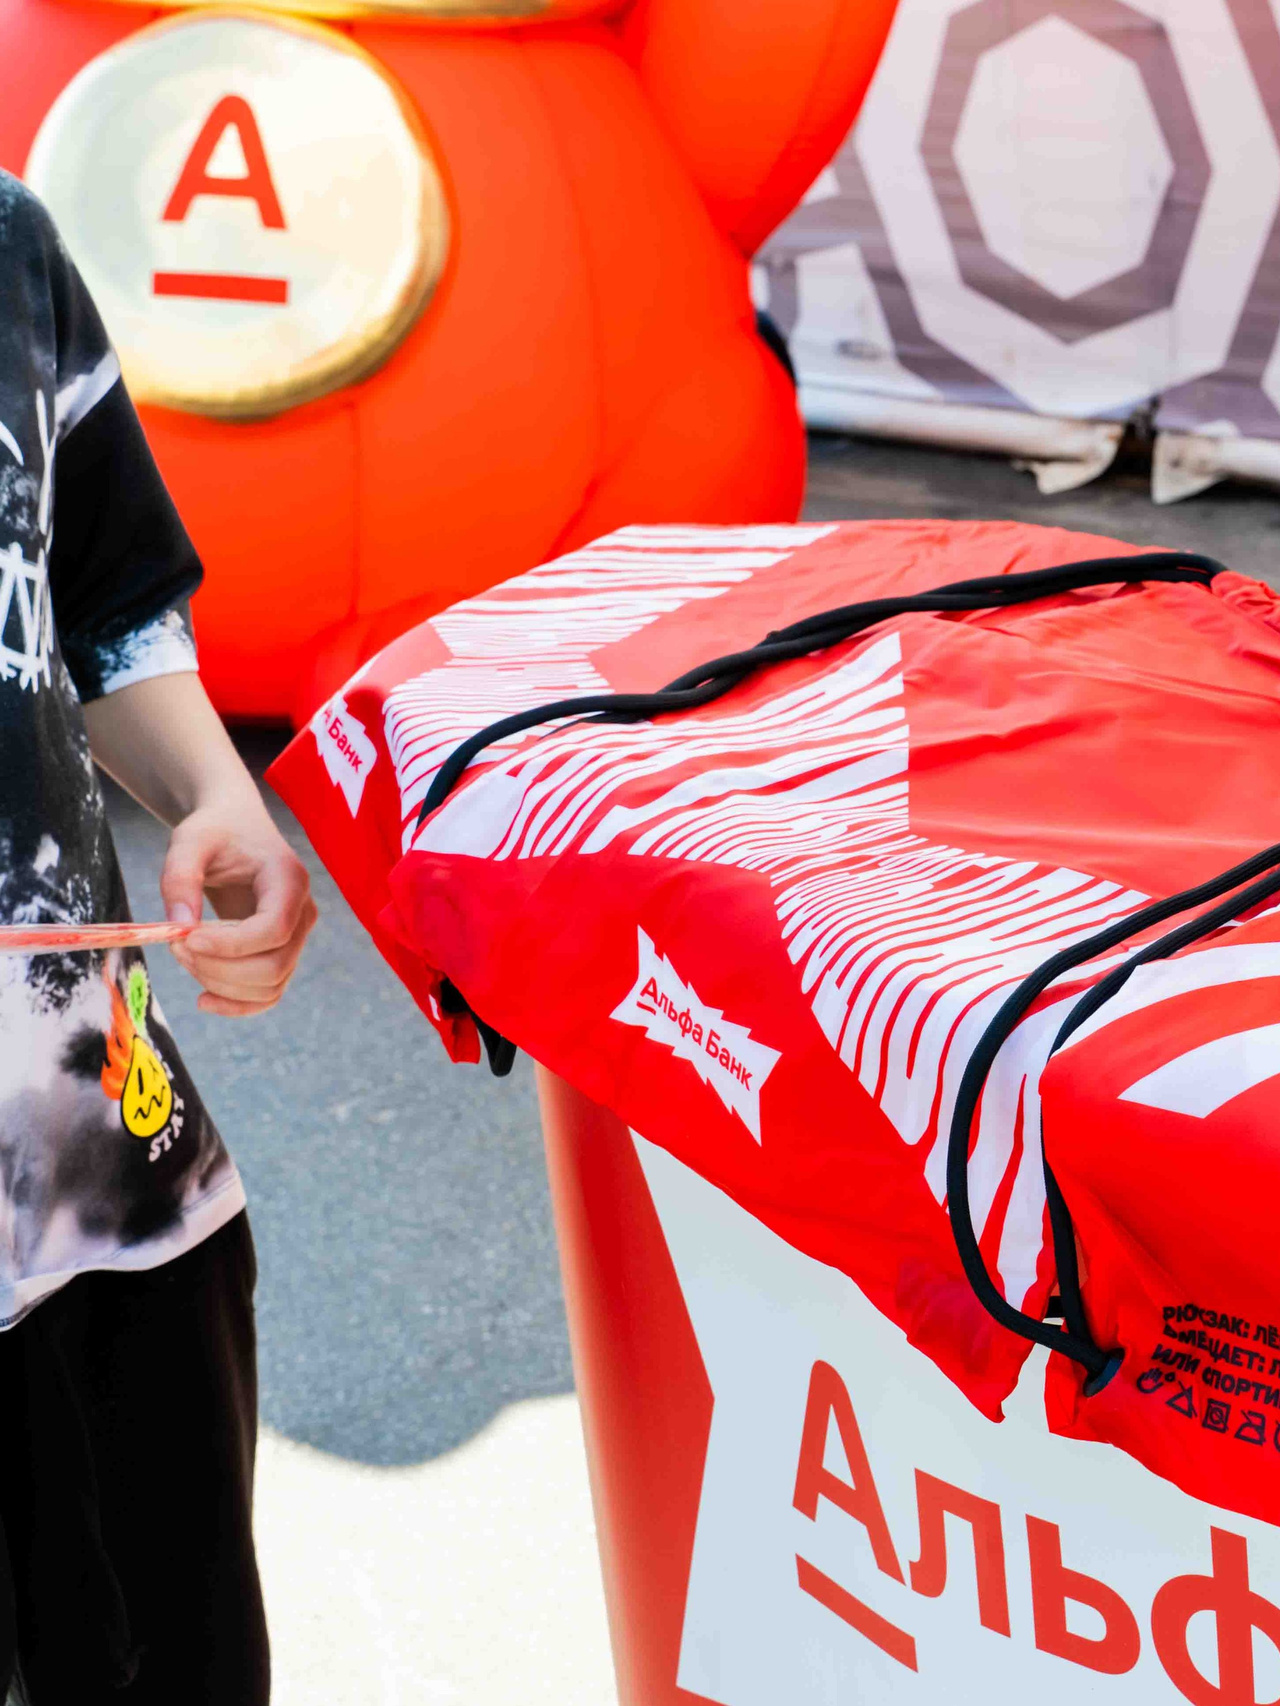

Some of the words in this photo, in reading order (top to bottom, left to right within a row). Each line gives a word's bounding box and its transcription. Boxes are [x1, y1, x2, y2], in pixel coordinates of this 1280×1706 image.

[328, 716, 364, 774] Банк
[639, 976, 704, 1046] Альфа
[705, 1028, 753, 1092] Банк
[1150, 1343, 1201, 1375] ИЛИ
